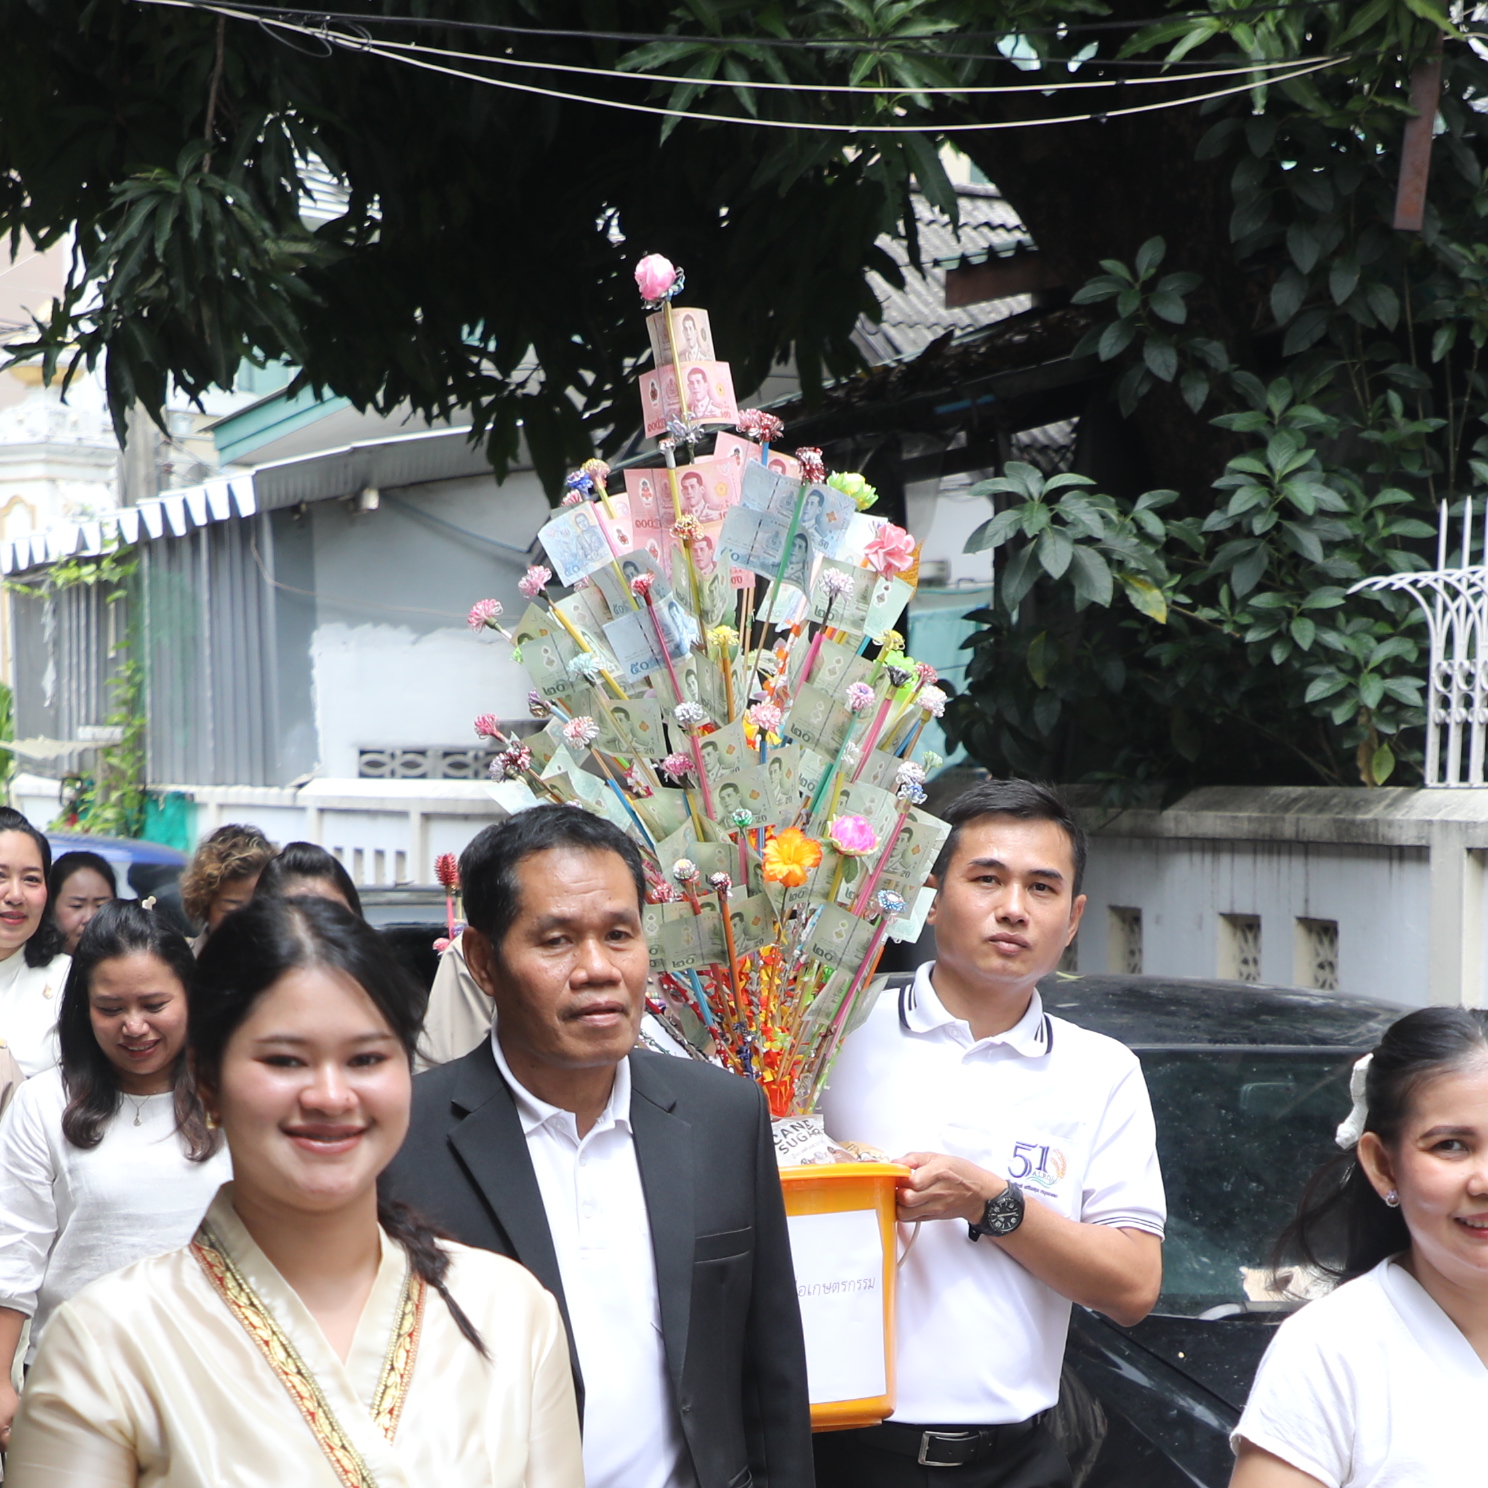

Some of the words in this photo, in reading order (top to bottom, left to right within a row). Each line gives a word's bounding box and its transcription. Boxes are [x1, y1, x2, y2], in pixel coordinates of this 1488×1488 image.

[630, 661, 649, 675] ๕๐
[542, 680, 566, 696] ๒๐
[790, 723, 811, 743] ๒๐
[755, 814, 768, 823] 20
[900, 869, 911, 879] 20
[813, 943, 834, 962] ๒๐
[672, 957, 695, 968] ๒๐
[1008, 1141, 1050, 1179] 51
[797, 1277, 876, 1298] อเกษตรกรรม
